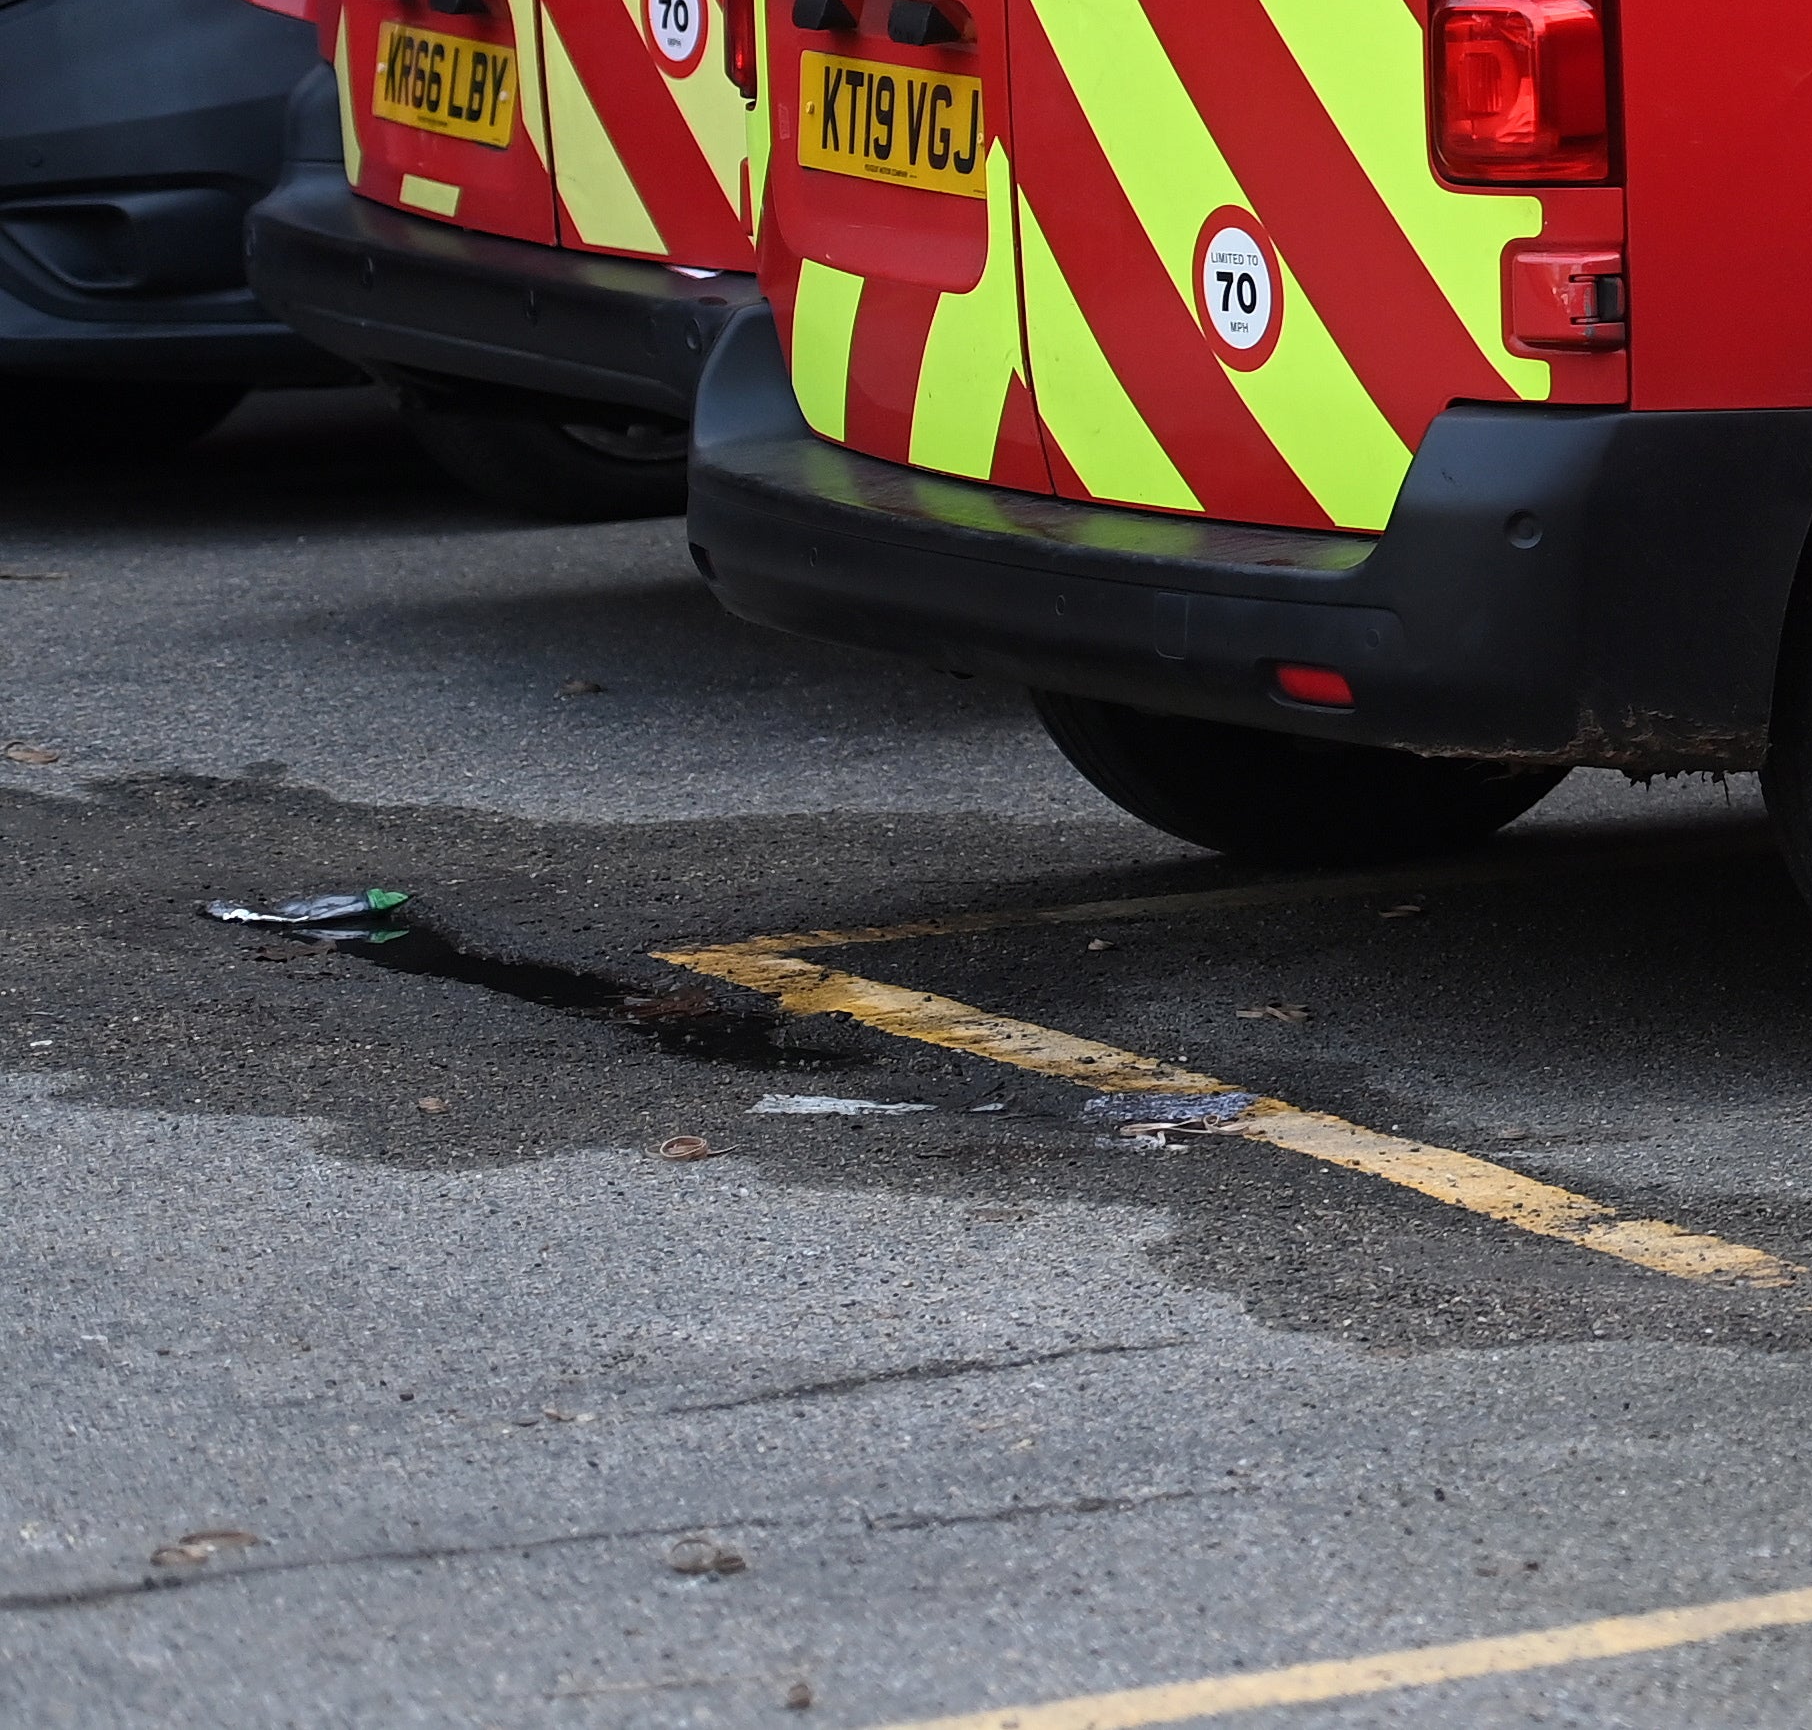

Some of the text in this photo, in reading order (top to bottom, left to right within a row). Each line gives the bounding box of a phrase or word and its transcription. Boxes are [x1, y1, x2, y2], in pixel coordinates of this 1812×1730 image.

[384, 31, 508, 127] KR66 LBY
[822, 66, 979, 175] KT19 VGJ
[1210, 252, 1259, 266] LIMITED TO
[1216, 271, 1257, 314] 70
[1230, 321, 1249, 333] MPH
